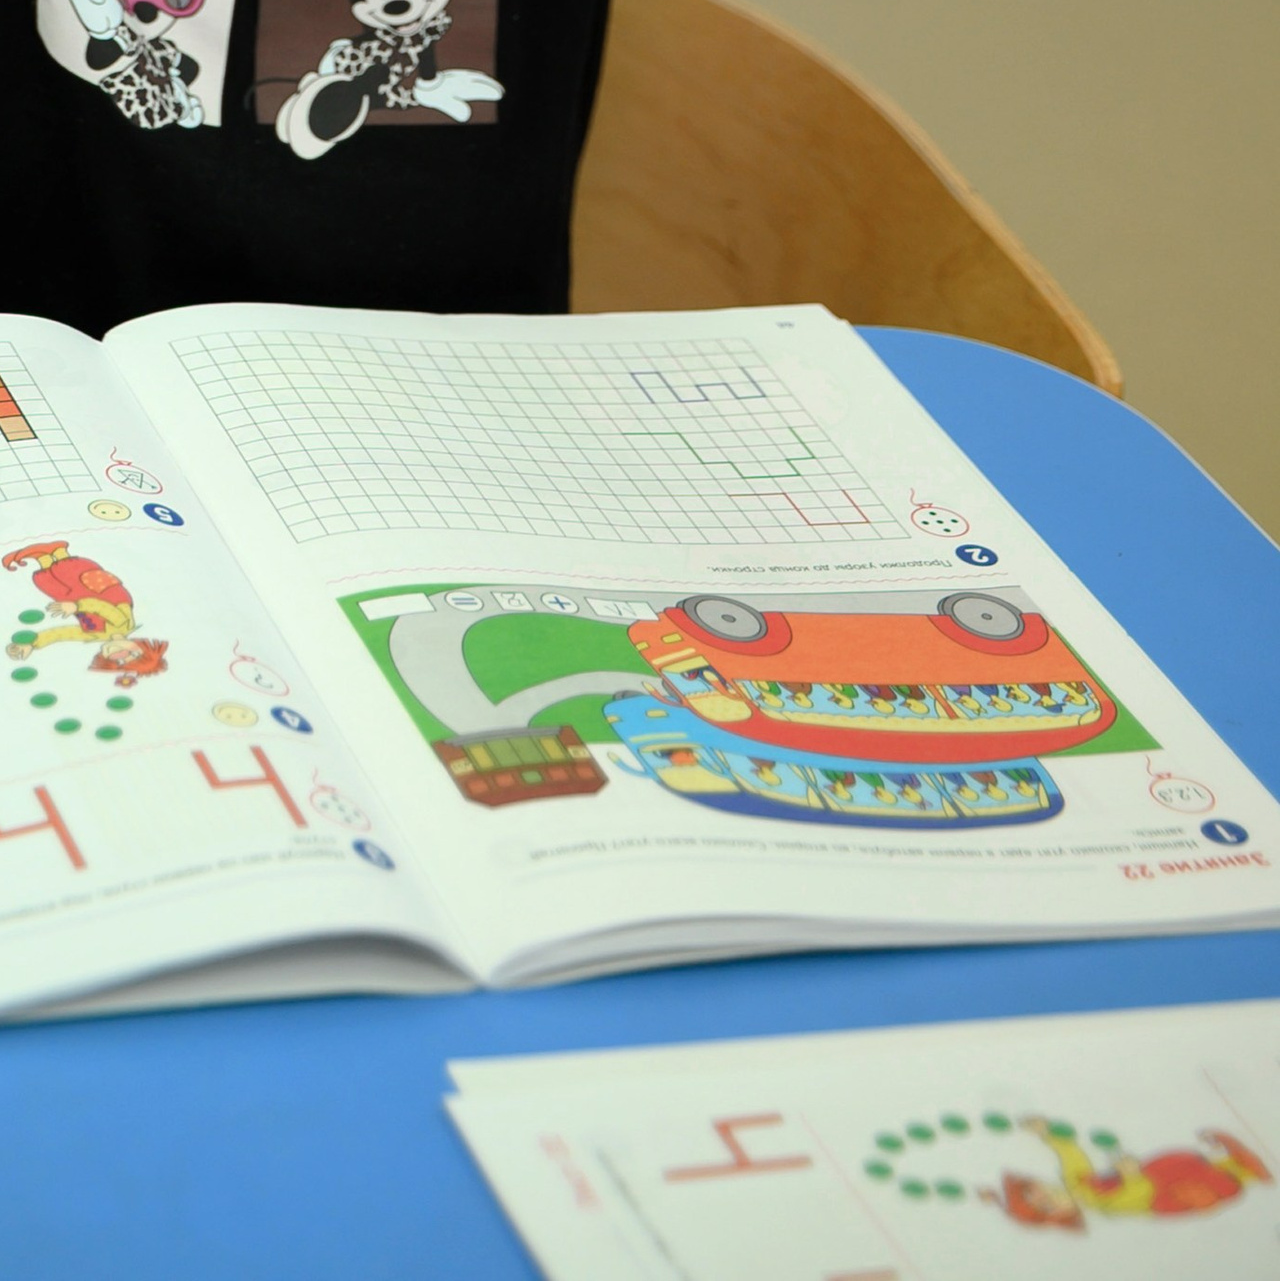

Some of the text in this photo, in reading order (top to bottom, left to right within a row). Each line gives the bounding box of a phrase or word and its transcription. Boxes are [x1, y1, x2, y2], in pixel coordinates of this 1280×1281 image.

[154, 506, 174, 523] 5
[964, 547, 990, 564] 2
[706, 558, 953, 574] Продолжи узоры до конца строчки.
[1214, 822, 1239, 843] 1
[1119, 851, 1271, 880] Занятие 22
